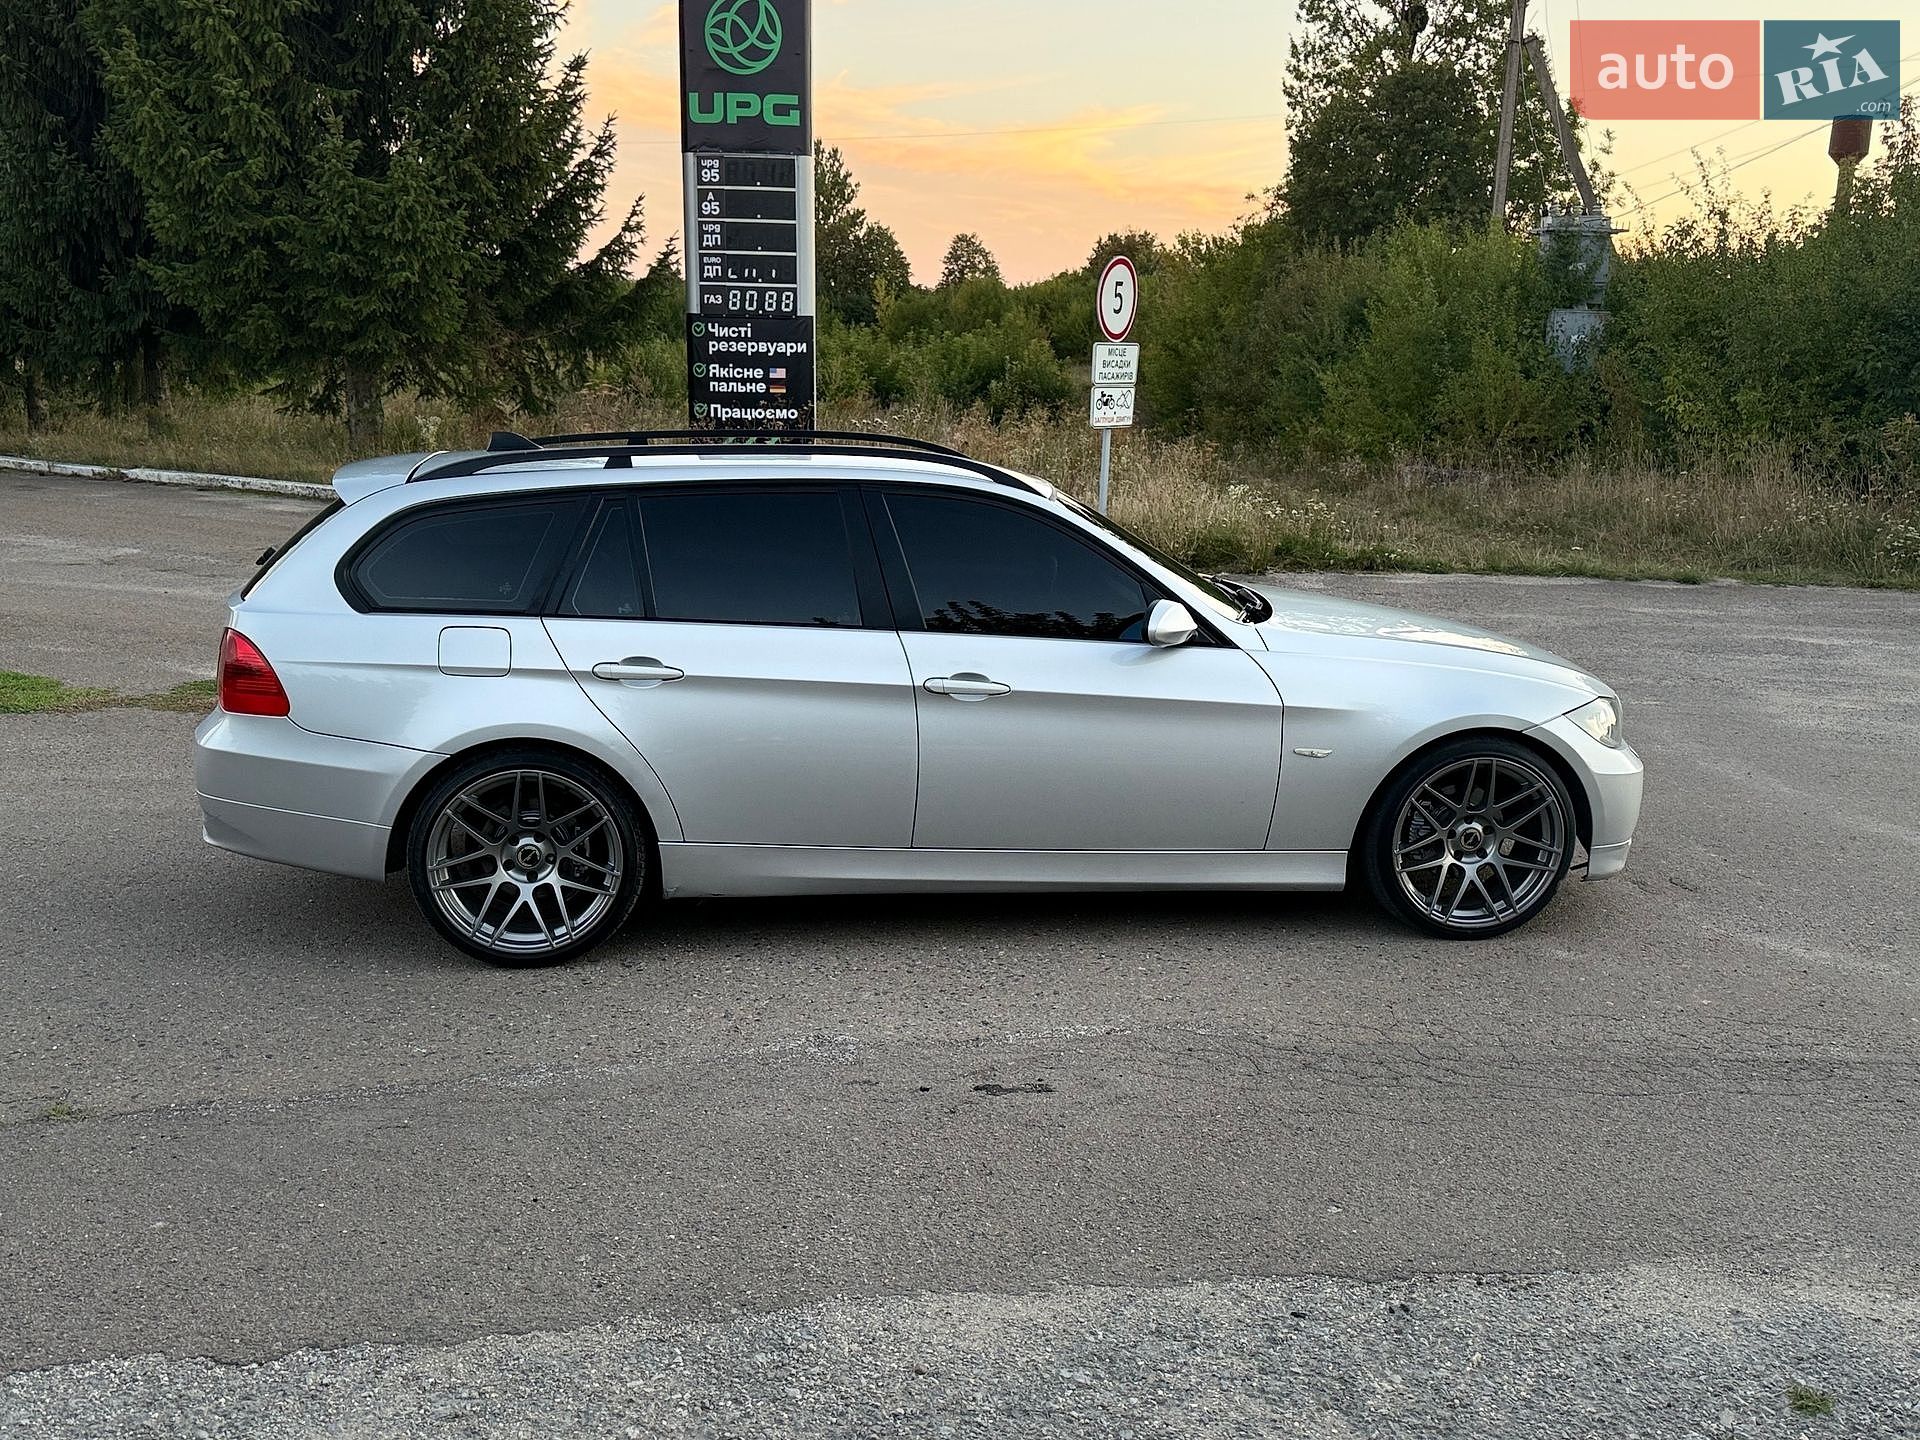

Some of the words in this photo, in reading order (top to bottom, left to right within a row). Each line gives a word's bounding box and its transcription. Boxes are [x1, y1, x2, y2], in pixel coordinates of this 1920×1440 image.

[688, 92, 800, 126] UPG
[701, 159, 719, 168] upg
[701, 169, 720, 182] 95
[701, 202, 720, 215] 95
[702, 224, 721, 233] upg
[703, 234, 721, 247] ДП
[703, 266, 722, 278] ДП
[704, 294, 722, 304] ГАЗ
[1113, 281, 1124, 315] 5
[707, 322, 752, 338] Чисті
[708, 341, 807, 356] резервуари
[709, 363, 764, 379] Якісне
[1102, 360, 1131, 369] ВИСАДКИ
[709, 381, 767, 393] пальне
[710, 404, 799, 421] Працюємо
